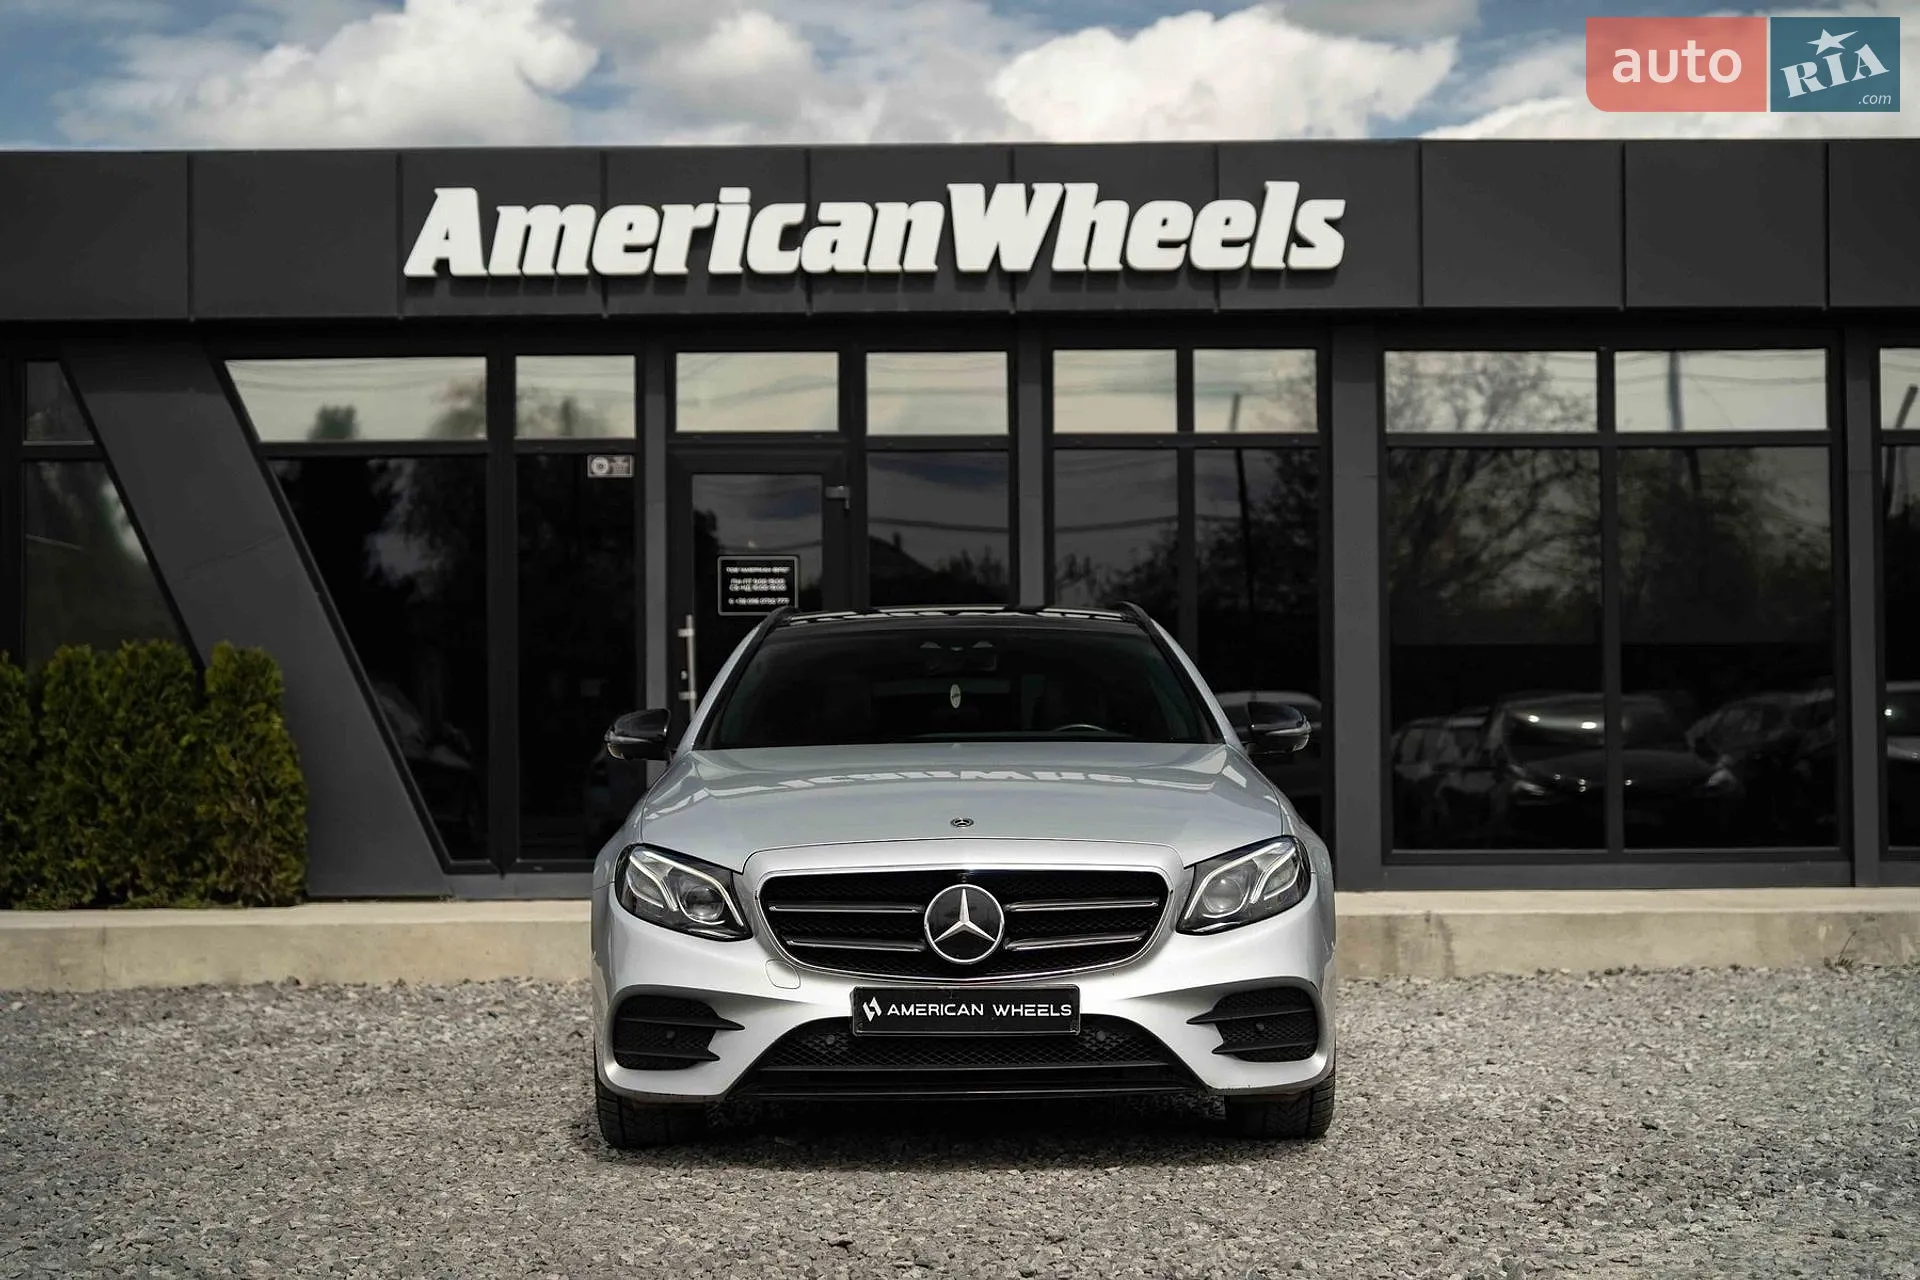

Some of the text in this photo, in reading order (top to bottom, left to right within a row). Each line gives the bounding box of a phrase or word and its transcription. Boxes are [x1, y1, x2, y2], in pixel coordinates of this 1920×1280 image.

[403, 180, 1346, 277] AmericanWheels
[887, 1003, 1072, 1017] AMERICAN WHEELS
